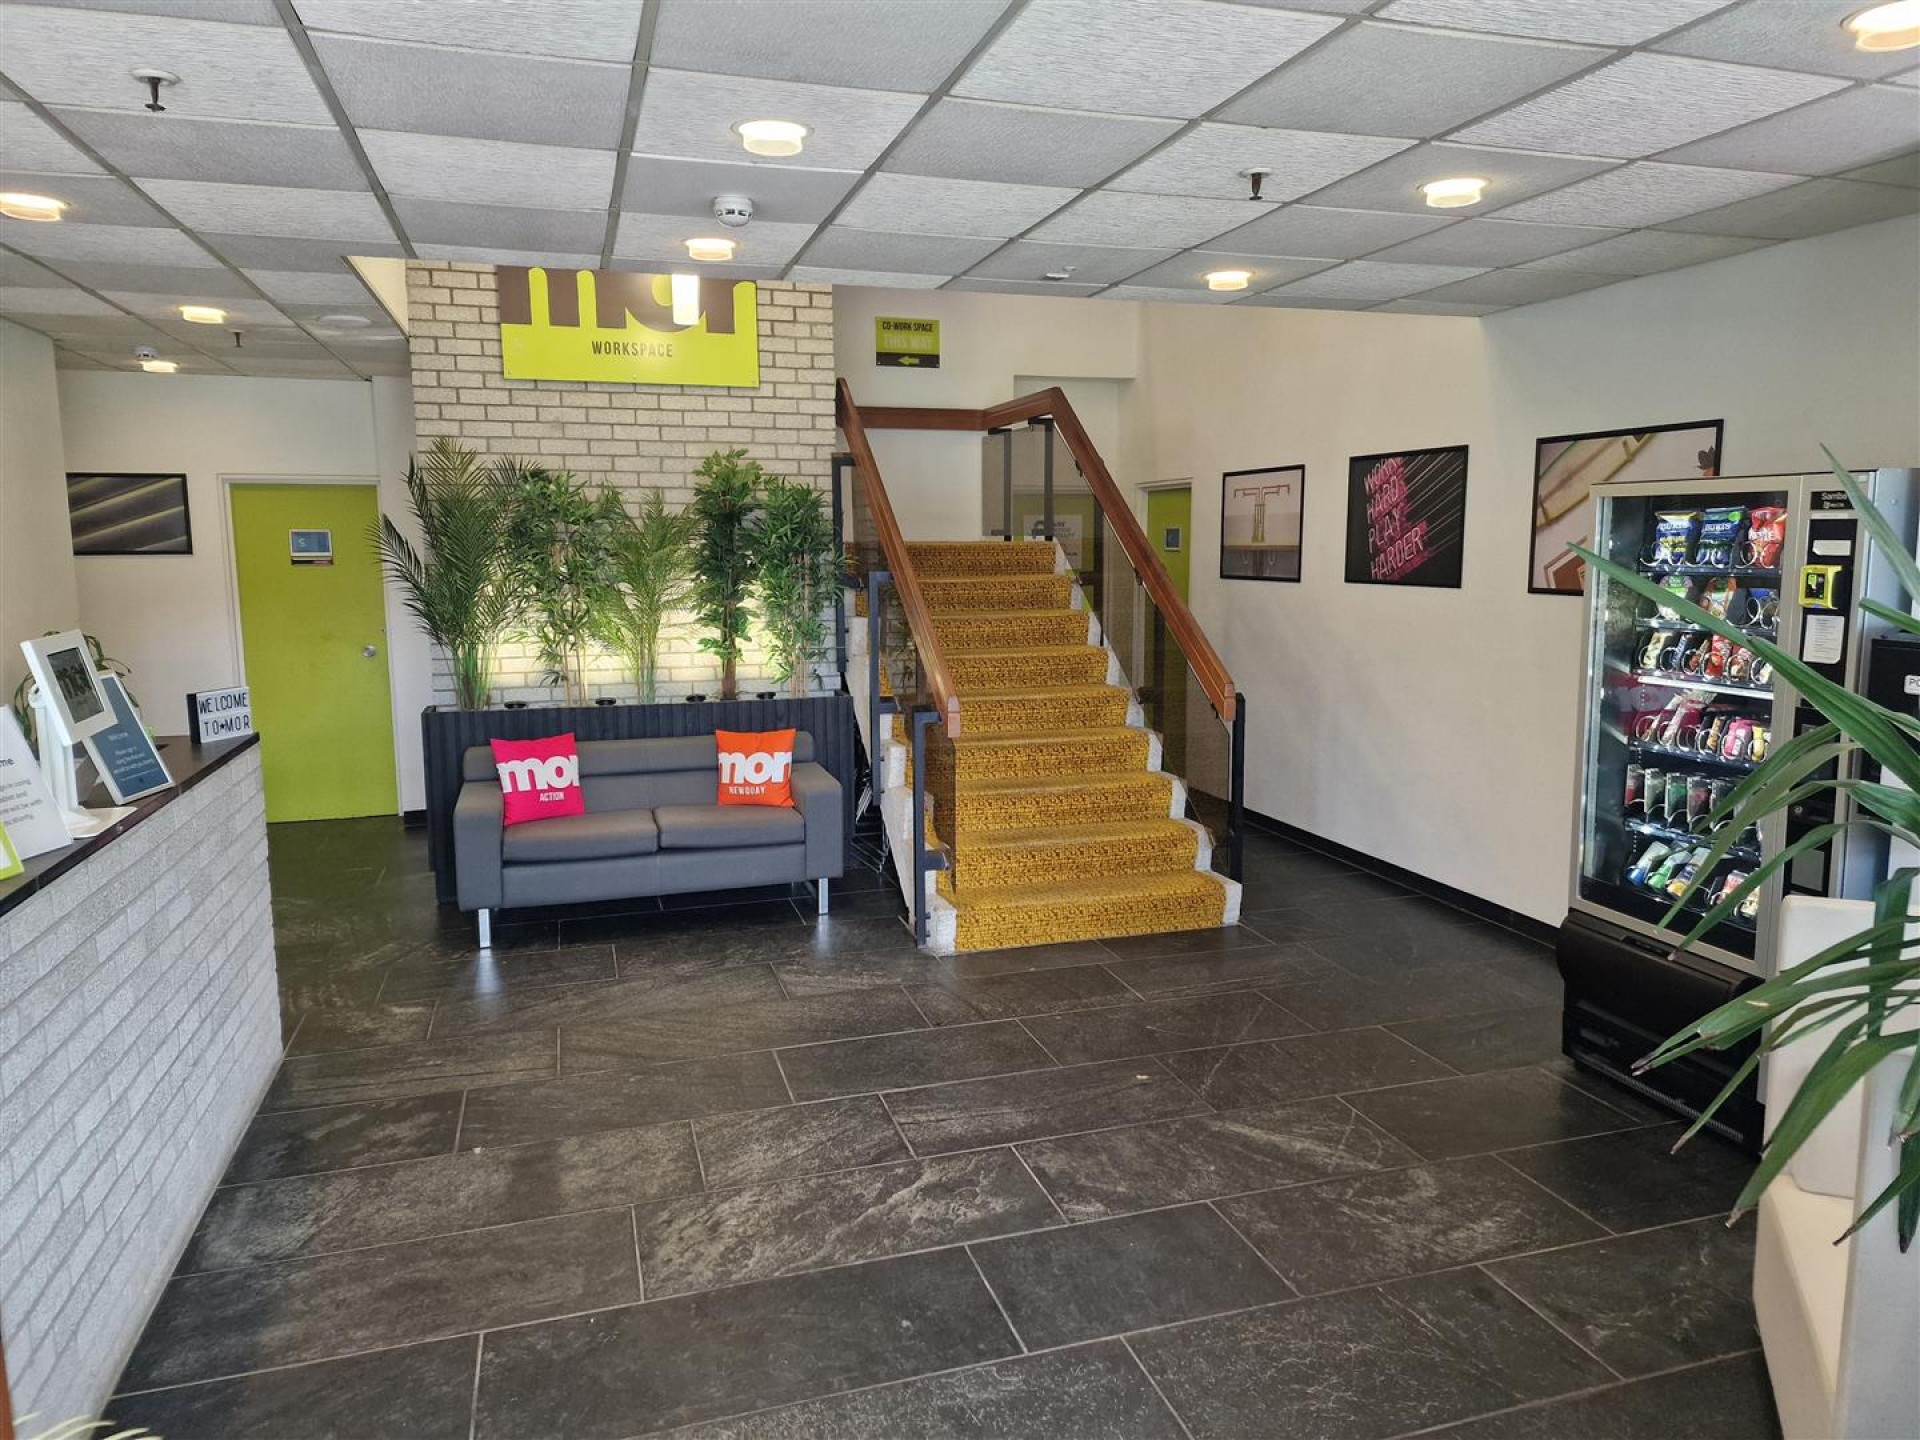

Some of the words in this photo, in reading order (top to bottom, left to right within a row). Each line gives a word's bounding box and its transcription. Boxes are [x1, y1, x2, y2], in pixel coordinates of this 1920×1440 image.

[592, 340, 673, 358] WORKSPACE
[1367, 475, 1400, 525] HARD
[1368, 506, 1402, 554] PLAY
[1371, 527, 1423, 580] HARDER
[199, 692, 249, 714] WELCOME
[203, 719, 220, 736] TO
[540, 791, 564, 802] ACTION
